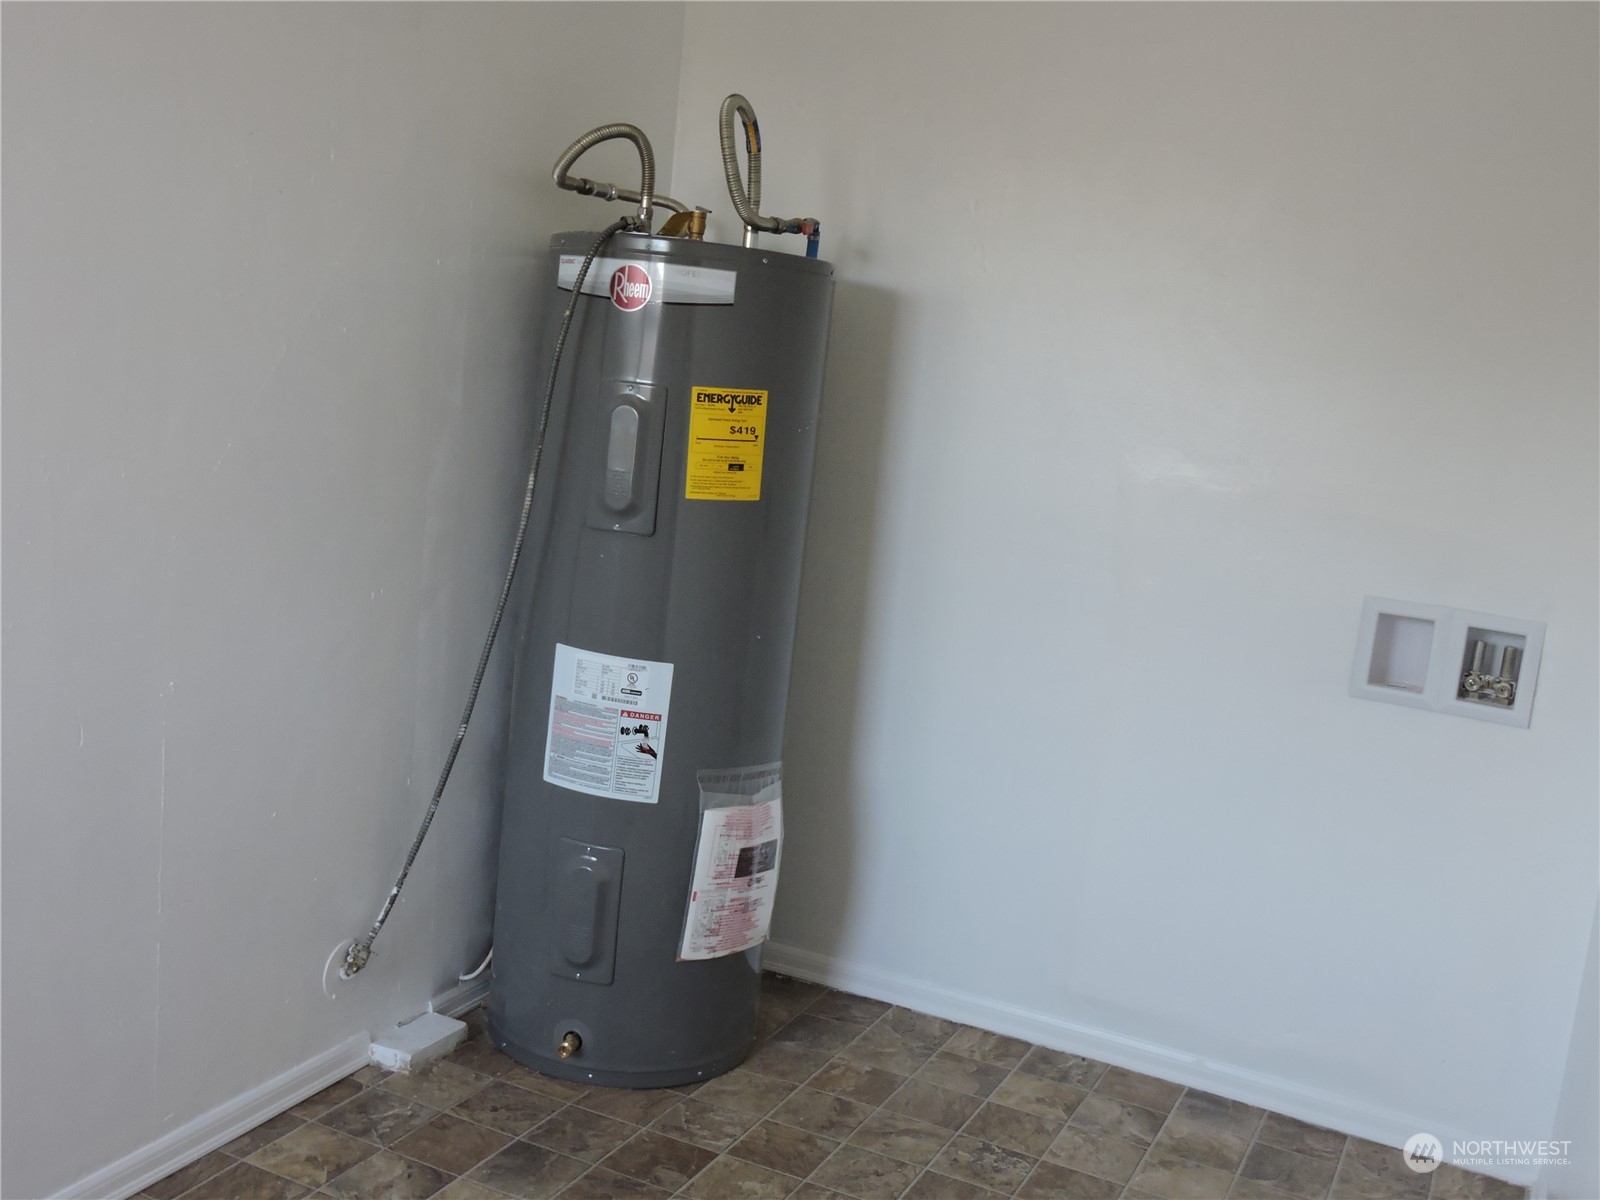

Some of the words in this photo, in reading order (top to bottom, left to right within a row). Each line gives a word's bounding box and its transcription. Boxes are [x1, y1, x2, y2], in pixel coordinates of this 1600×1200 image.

[613, 265, 650, 304] Rheem
[696, 392, 763, 406] ENERGYGUIDE
[729, 425, 757, 436] $419
[629, 710, 661, 721] DANGER
